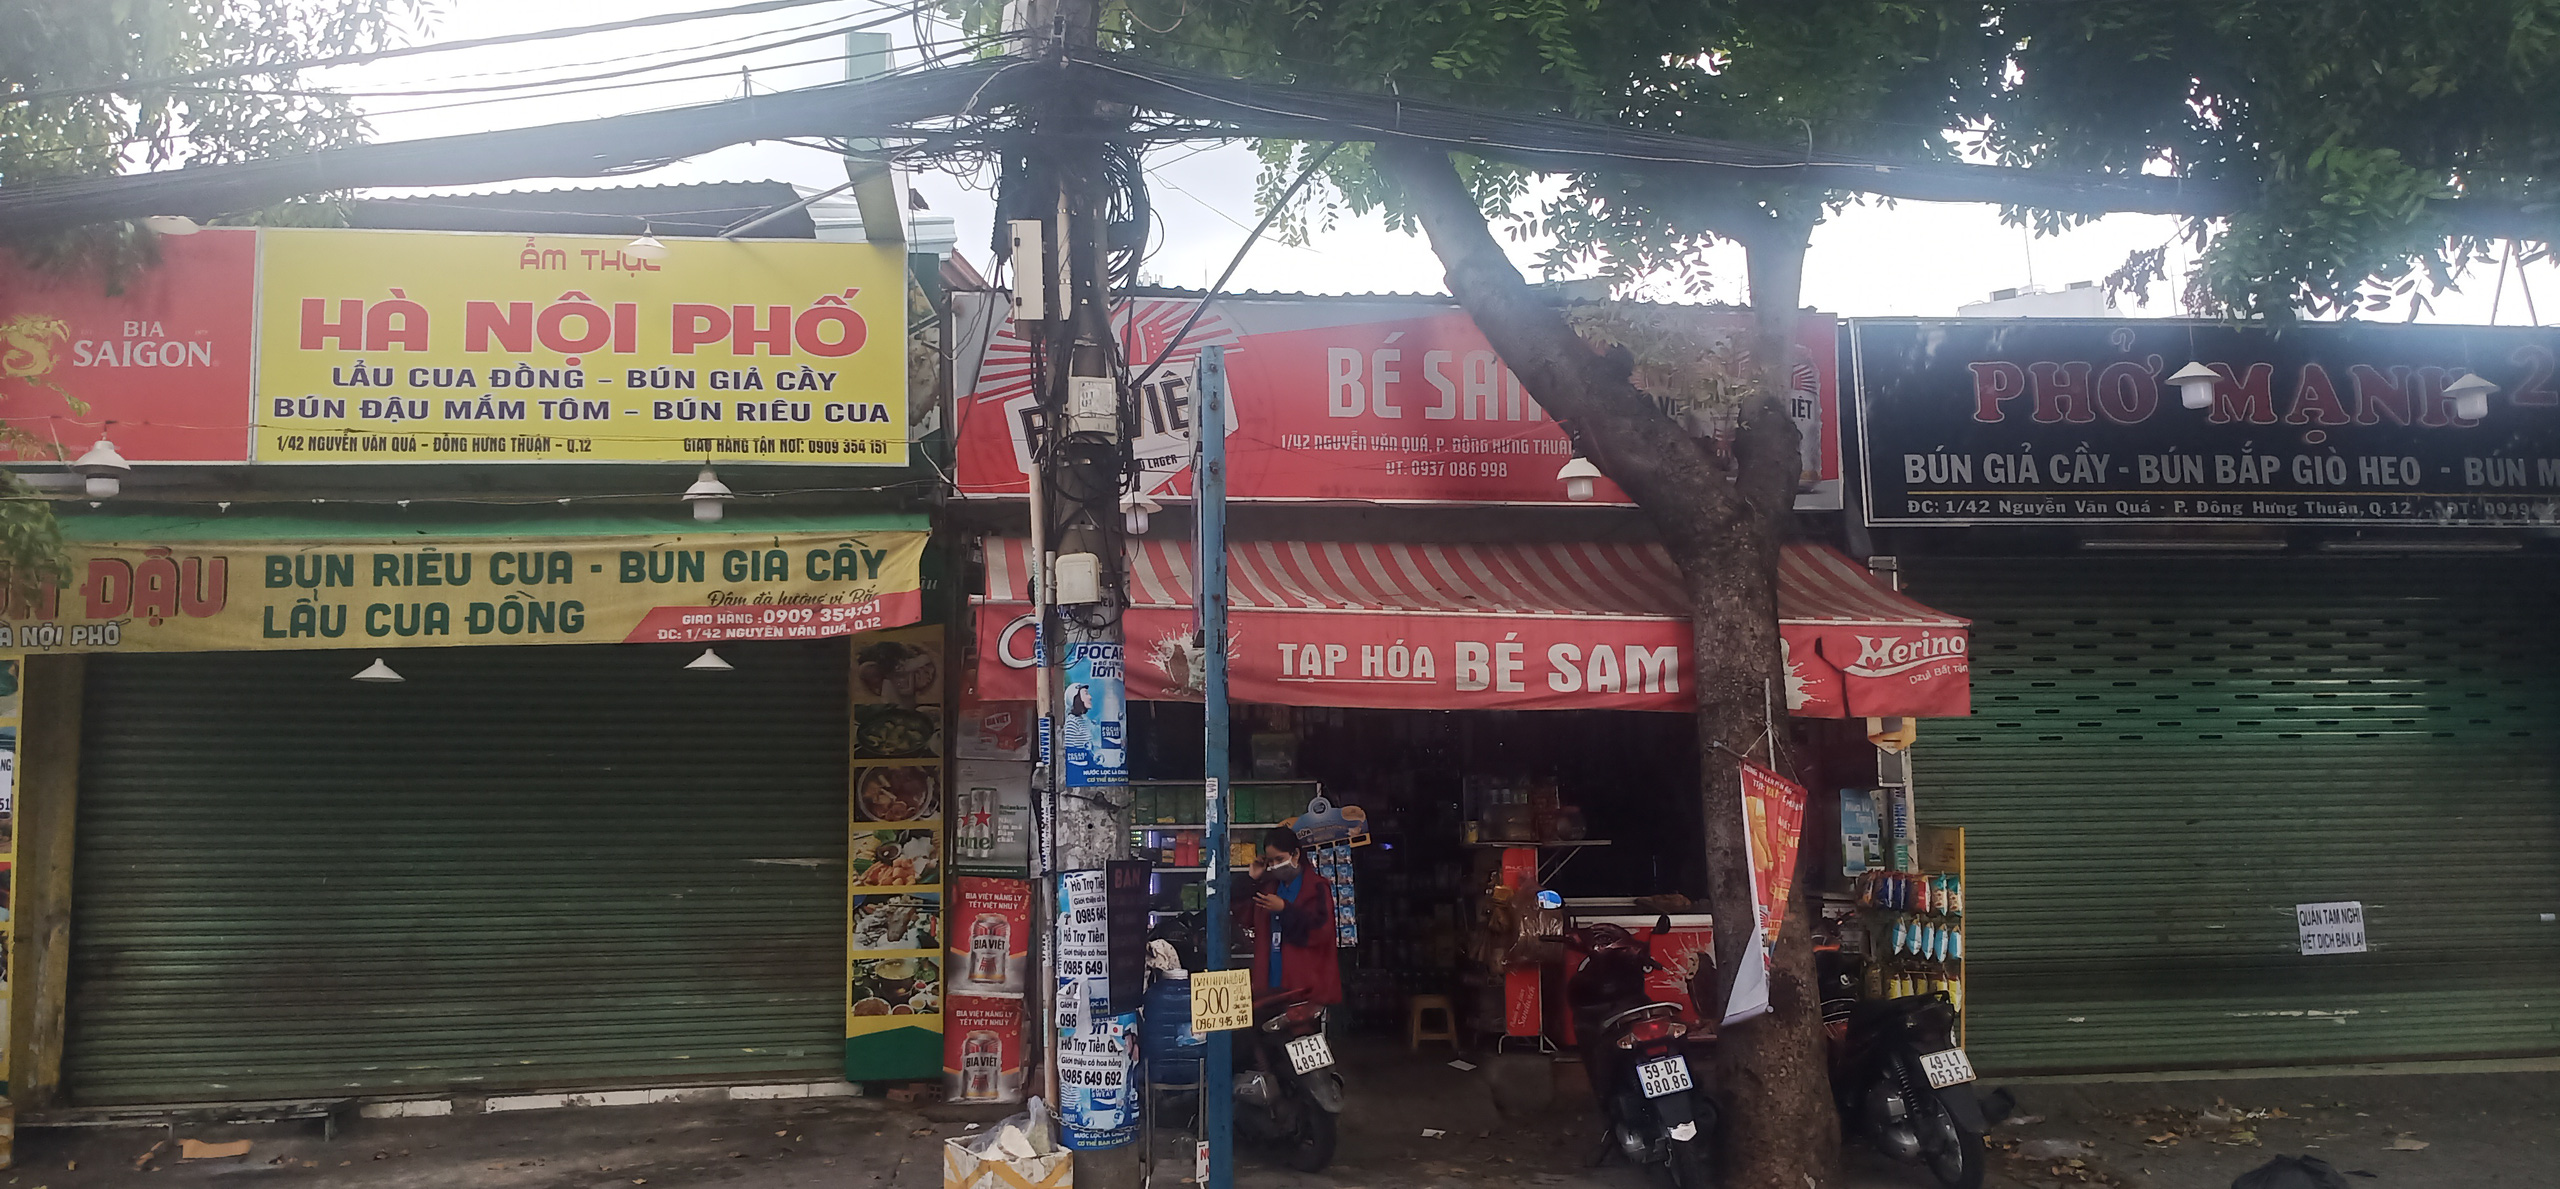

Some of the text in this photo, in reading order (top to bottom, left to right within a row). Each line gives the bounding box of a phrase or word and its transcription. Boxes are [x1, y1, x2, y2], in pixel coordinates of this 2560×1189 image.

[520, 236, 566, 270] ẨM
[123, 321, 164, 337] BIA
[300, 287, 868, 366] HÀ NỘI PHỐ
[73, 340, 212, 367] SAIGON
[333, 360, 838, 392] LẨU CUA ĐỒNG BÚN GIẢ CẦY
[1328, 332, 1401, 421] BÉ
[1968, 327, 2163, 424] PHỞ
[274, 393, 890, 424] BÚN ĐẬU MẮM TÔM BÚN RIÊU CUA
[277, 431, 592, 456] 1/42 NGUYỄN VĂN QUÁ ĐÔNG HƯNG THUẬN Q.12
[716, 435, 749, 453] HÀNG
[809, 440, 839, 454] 0909
[843, 440, 866, 454] 354
[1281, 434, 1310, 450] 1/42
[1314, 430, 1367, 451] NGUYỄN
[1371, 434, 1398, 451] VĂN
[1149, 454, 1178, 469] LAGER
[1412, 461, 1444, 476] 0937
[1450, 462, 1477, 477] 086
[1481, 462, 1507, 477] 998
[1904, 441, 2527, 487] BÚN GIẢ CẦY BÚN BẮP GIÒ HEO BÚN
[1908, 500, 1939, 513] ĐC:
[1945, 500, 1991, 513] 1/42
[1999, 497, 2066, 515] Nguyễn
[2077, 500, 2107, 513] Văn
[2116, 500, 2150, 514] Quá
[2174, 501, 2188, 513] P.
[2197, 500, 2243, 516] Đông
[2253, 501, 2297, 516] Hưng
[2369, 502, 2412, 515] Q.12
[265, 536, 888, 588] BÚN RIÊU CUA BÚN GIẢ CẦY
[80, 546, 228, 627] ĐẬU
[365, 602, 450, 637] CUA
[464, 590, 584, 635] ĐỒNG
[682, 610, 753, 625] GIAO HÀNG
[21, 619, 131, 650] NỘI PHỐ
[658, 628, 682, 639] ĐC:
[686, 628, 721, 640] 1/42
[726, 624, 784, 639] NGUYỄN
[788, 625, 816, 638] VĂN
[1854, 630, 1966, 666] Merino
[1278, 632, 1679, 693] TẠP HÓA BÉ SAM
[1076, 908, 1096, 924] 0985
[2300, 905, 2323, 926] QUÁN
[974, 939, 987, 949] BIA
[1073, 930, 1086, 946] Trợ
[1088, 927, 1105, 943] Tiền
[1064, 960, 1103, 975] 0985 649
[1195, 986, 1229, 1017] 500
[1074, 1038, 1086, 1054] Trợ
[1089, 1036, 1105, 1052] Tiền
[966, 1057, 979, 1067] BIA
[1096, 1058, 1107, 1067] hoa
[1061, 1068, 1122, 1086] 0985 649 692
[1646, 1074, 1689, 1095] 980.86
